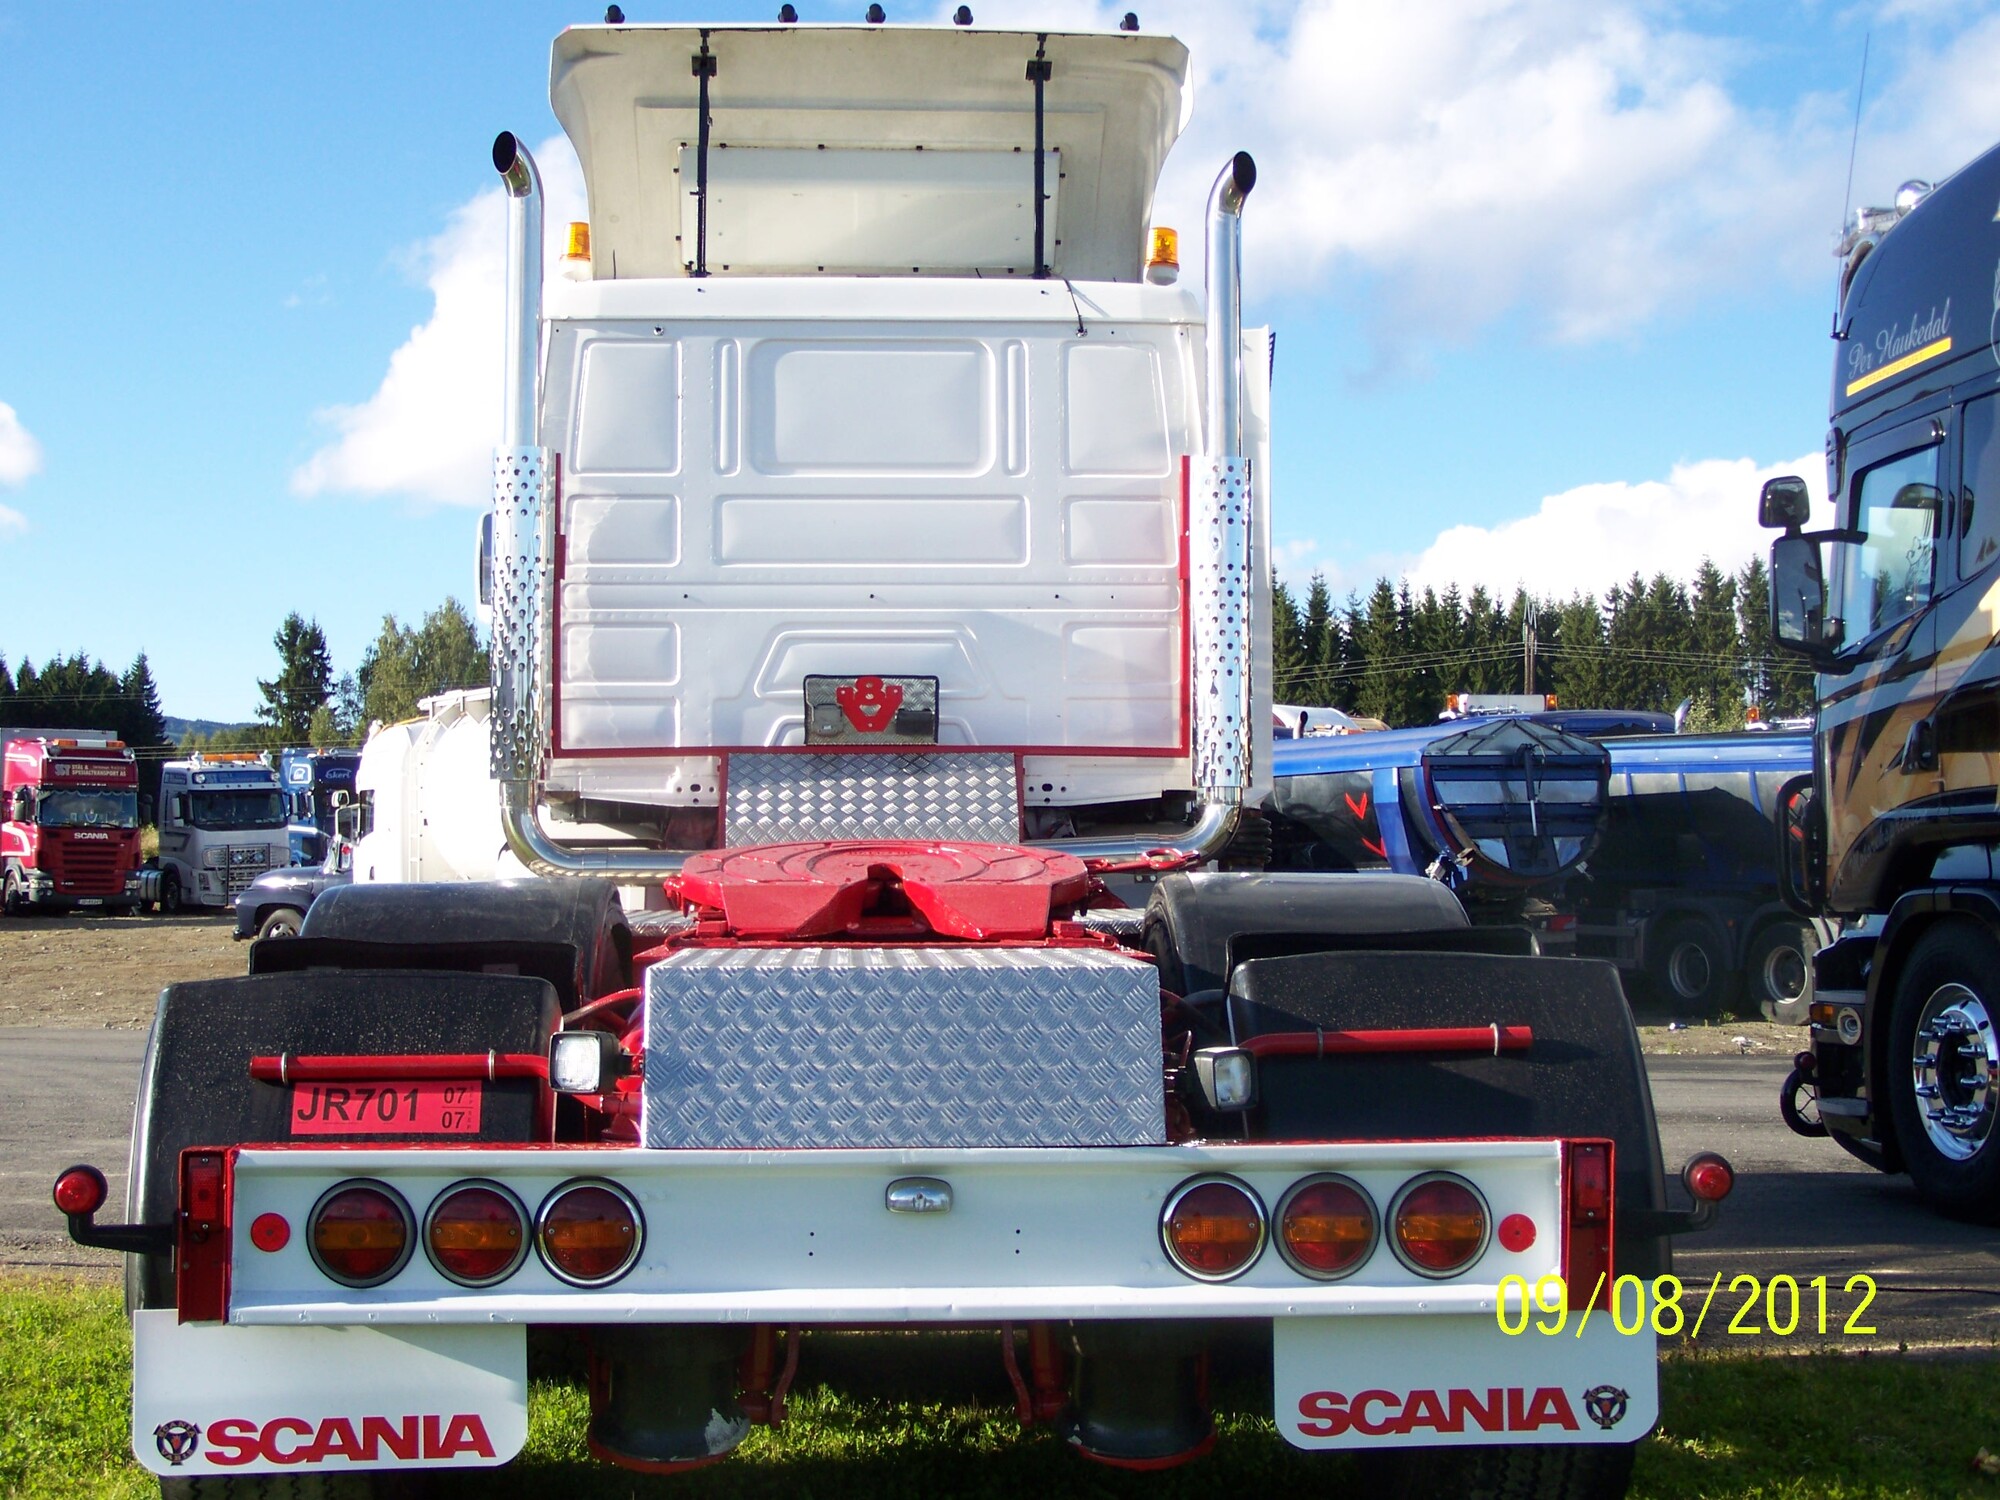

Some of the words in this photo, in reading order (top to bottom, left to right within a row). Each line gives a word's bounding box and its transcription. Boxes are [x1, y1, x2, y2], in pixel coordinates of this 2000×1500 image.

[1849, 342, 1873, 379] Per
[297, 1087, 420, 1122] JR701
[444, 1087, 468, 1104] 07
[441, 1111, 465, 1129] 07
[1297, 1388, 1580, 1437] SCANIA
[204, 1414, 497, 1466] SCANIA
